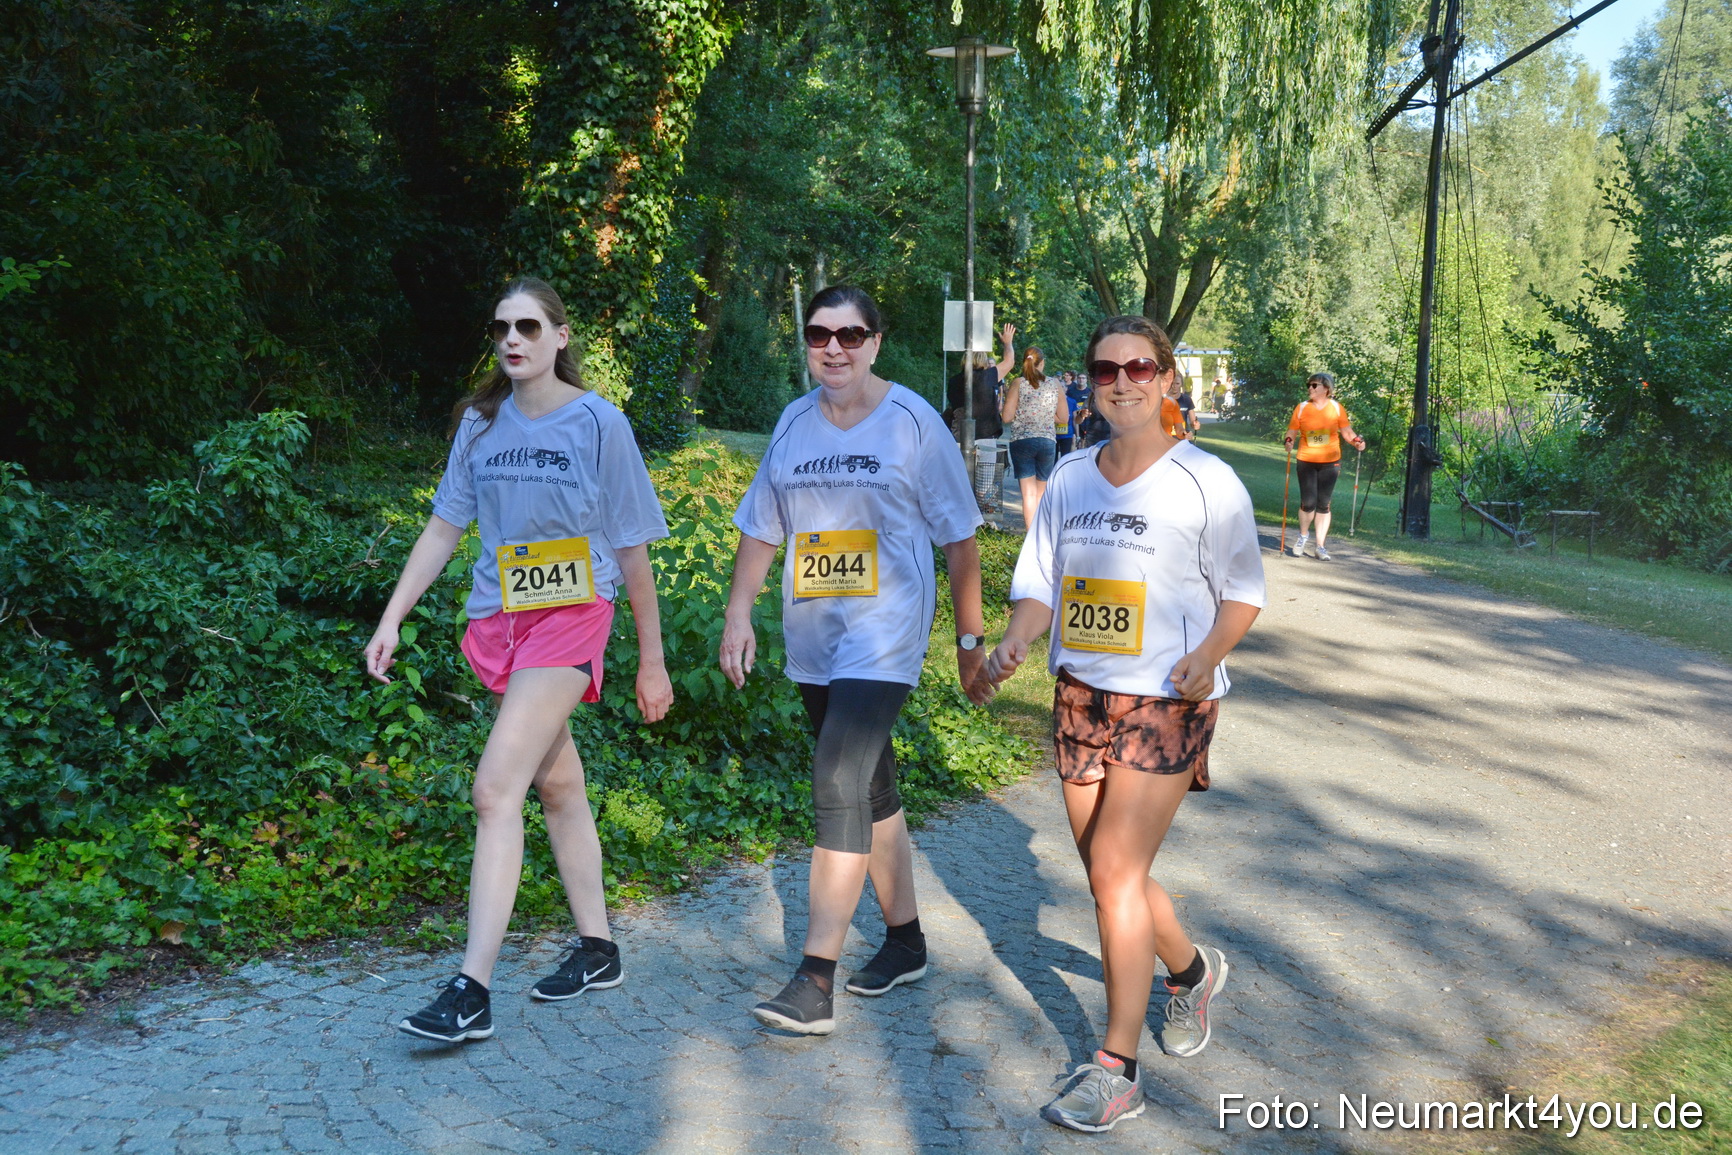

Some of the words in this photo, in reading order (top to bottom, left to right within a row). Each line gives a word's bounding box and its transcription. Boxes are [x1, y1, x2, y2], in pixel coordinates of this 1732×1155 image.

[1313, 435, 1323, 443] 96
[520, 473, 543, 483] Lukas
[784, 480, 832, 491] Waldkalkung
[833, 480, 854, 488] Lukas
[856, 479, 890, 491] Schmidt
[1090, 536, 1115, 547] Lukas
[1117, 539, 1155, 556] Schmidt
[803, 553, 866, 578] 2044
[511, 562, 578, 592] 2041
[524, 589, 553, 598] Schmidt
[516, 597, 546, 605] Waldkalkung
[1068, 602, 1130, 633] 2038
[1079, 630, 1096, 638] Klaus
[1097, 632, 1114, 640] Viola
[1069, 637, 1093, 645] Waldkalkung
